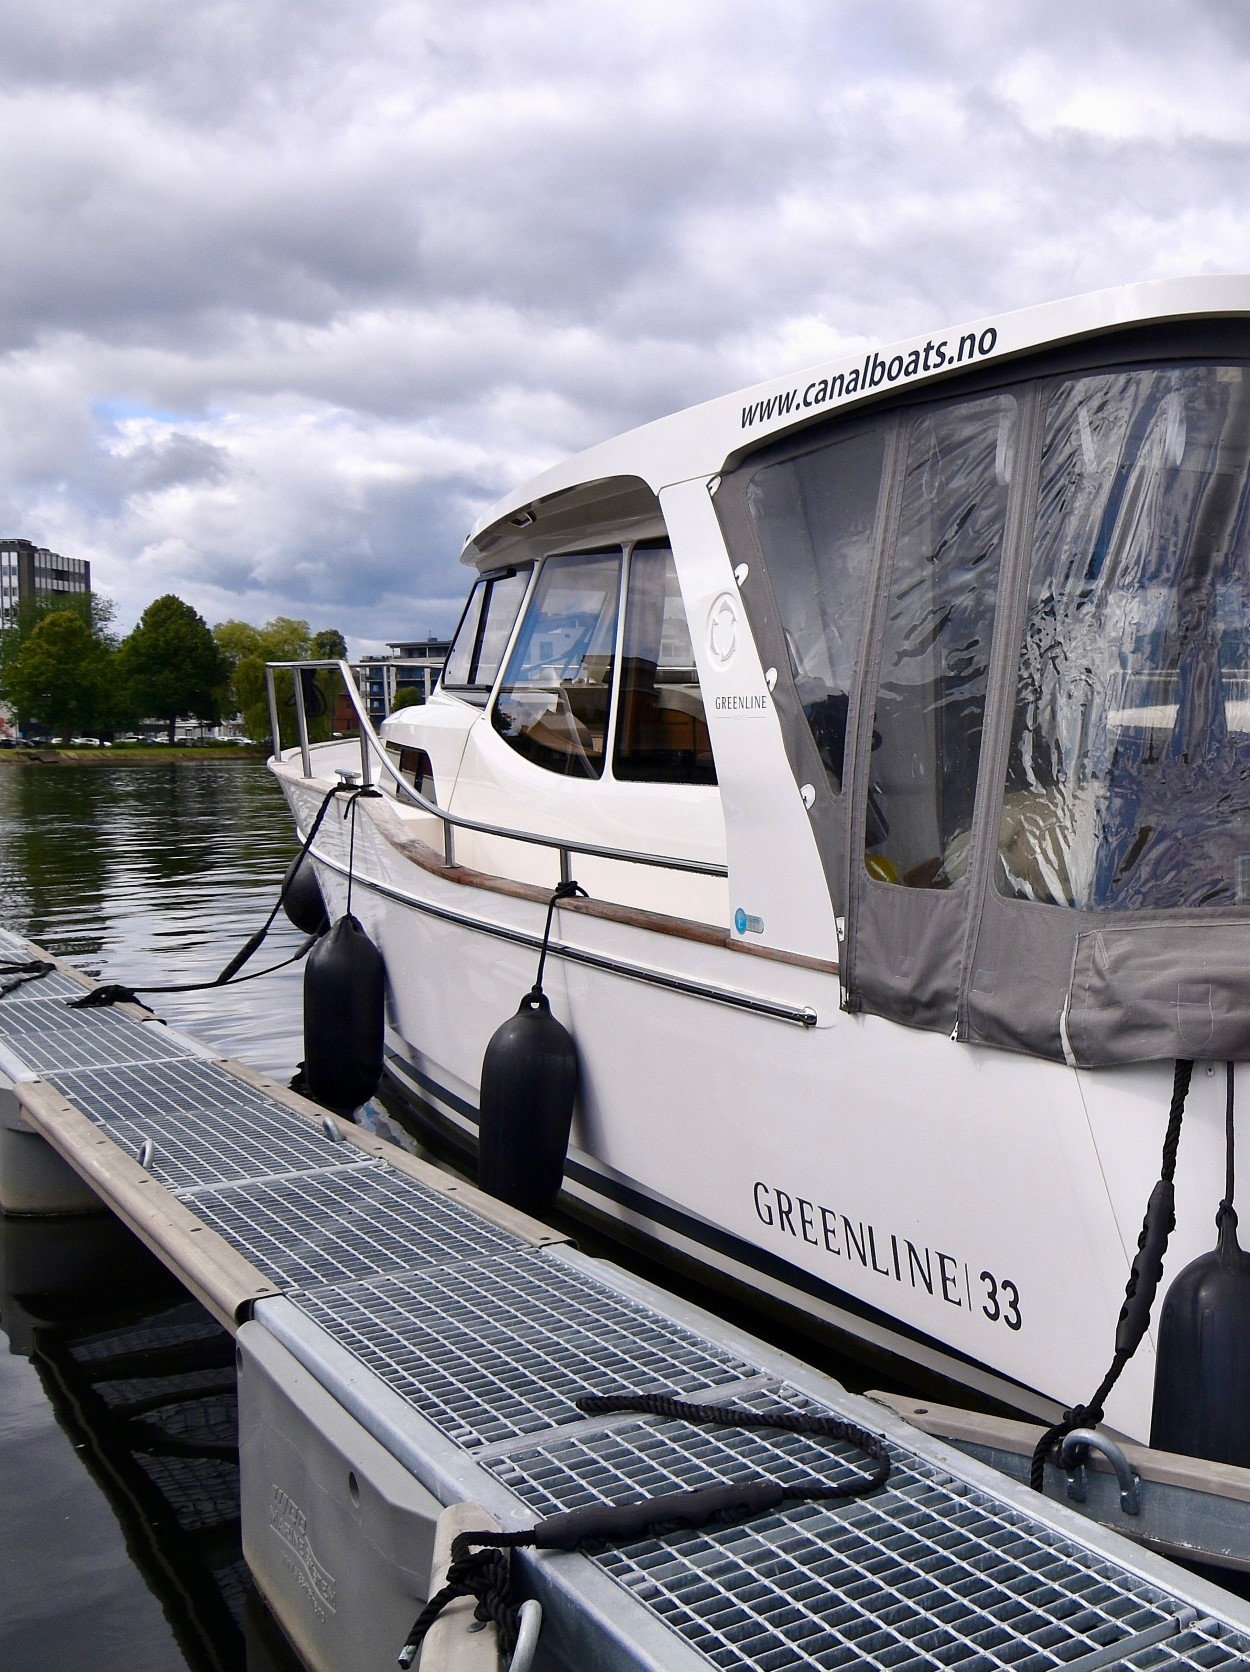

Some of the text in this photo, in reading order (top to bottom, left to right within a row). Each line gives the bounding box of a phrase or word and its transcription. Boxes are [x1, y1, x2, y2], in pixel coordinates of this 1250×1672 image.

[741, 327, 997, 429] www.canalboats.no
[715, 695, 767, 710] GREENLINE
[753, 1181, 1022, 1331] GREENLINE 33
